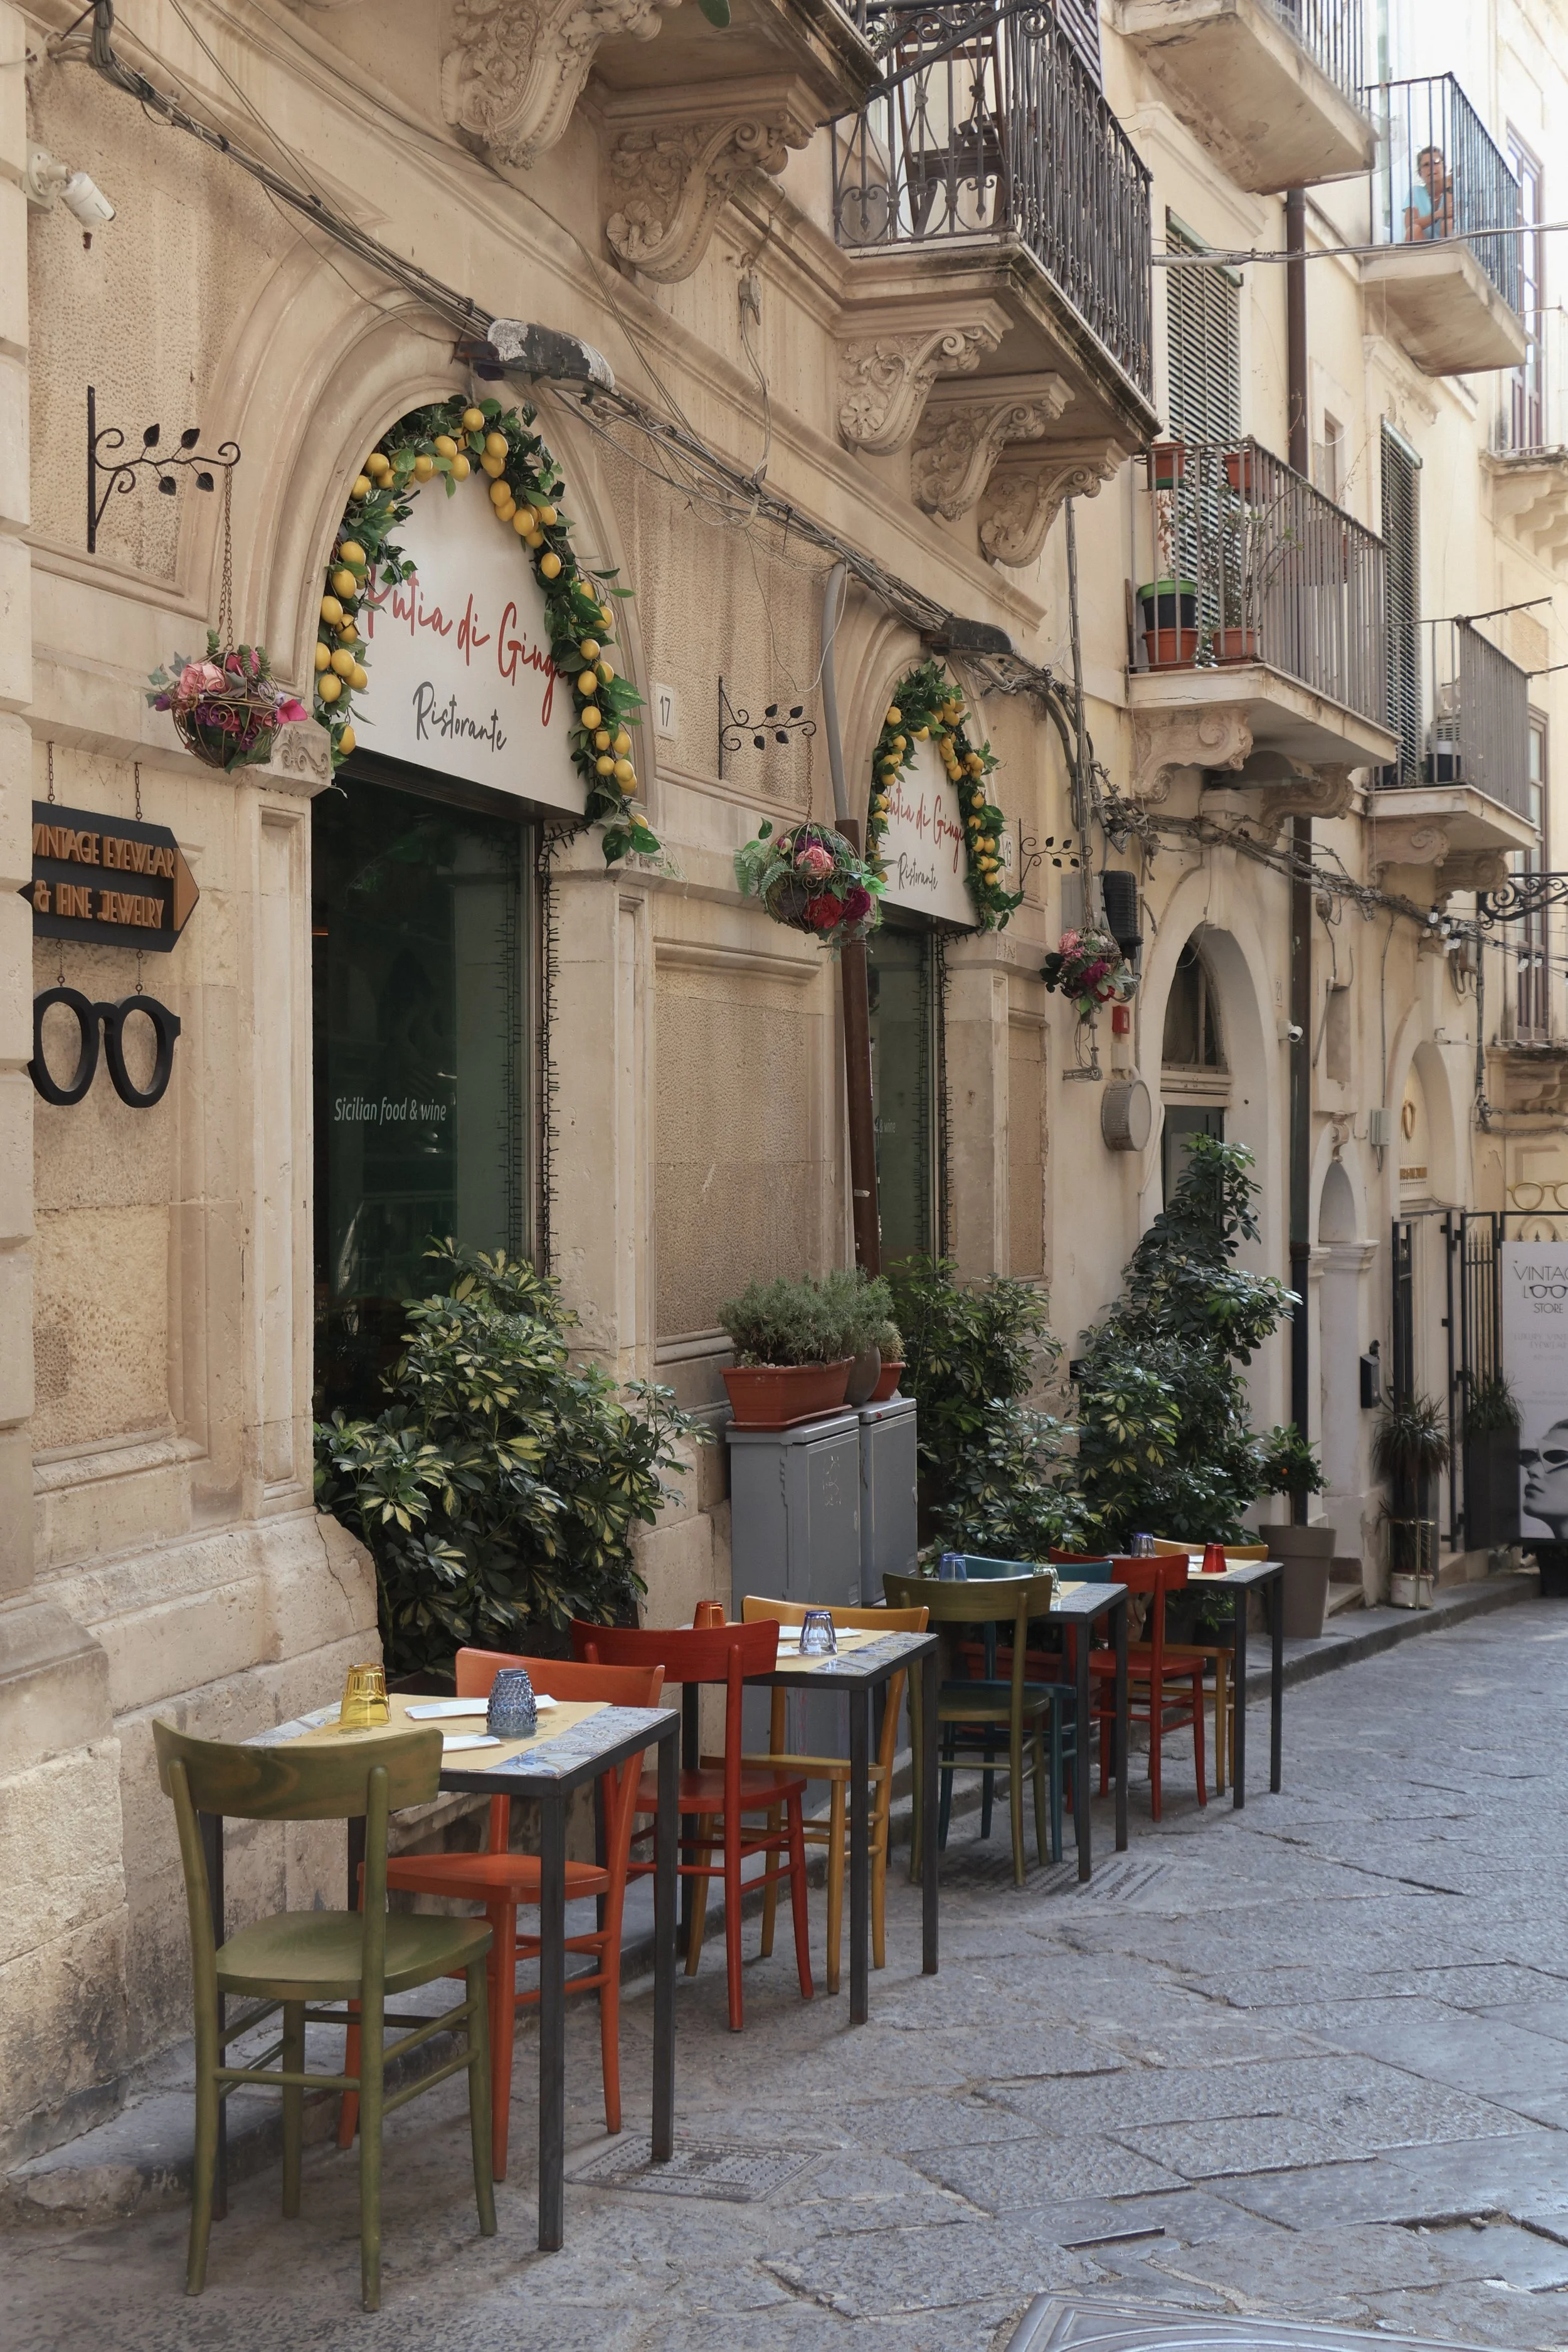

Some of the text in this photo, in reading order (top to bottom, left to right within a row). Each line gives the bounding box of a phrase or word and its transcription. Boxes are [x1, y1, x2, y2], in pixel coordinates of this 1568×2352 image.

[457, 593, 490, 667] di
[412, 681, 507, 753] Ristorante
[660, 695, 670, 727] 17
[887, 782, 914, 825] utia
[916, 793, 931, 840] di
[33, 823, 174, 878] VINTAGE EYEWEAR
[898, 852, 938, 891] Ristorante
[1005, 840, 1012, 867] 19
[33, 879, 164, 929] & FINE JEWELRY
[334, 1096, 447, 1126] Sicilian food & wine
[1534, 1303, 1564, 1314] STORE
